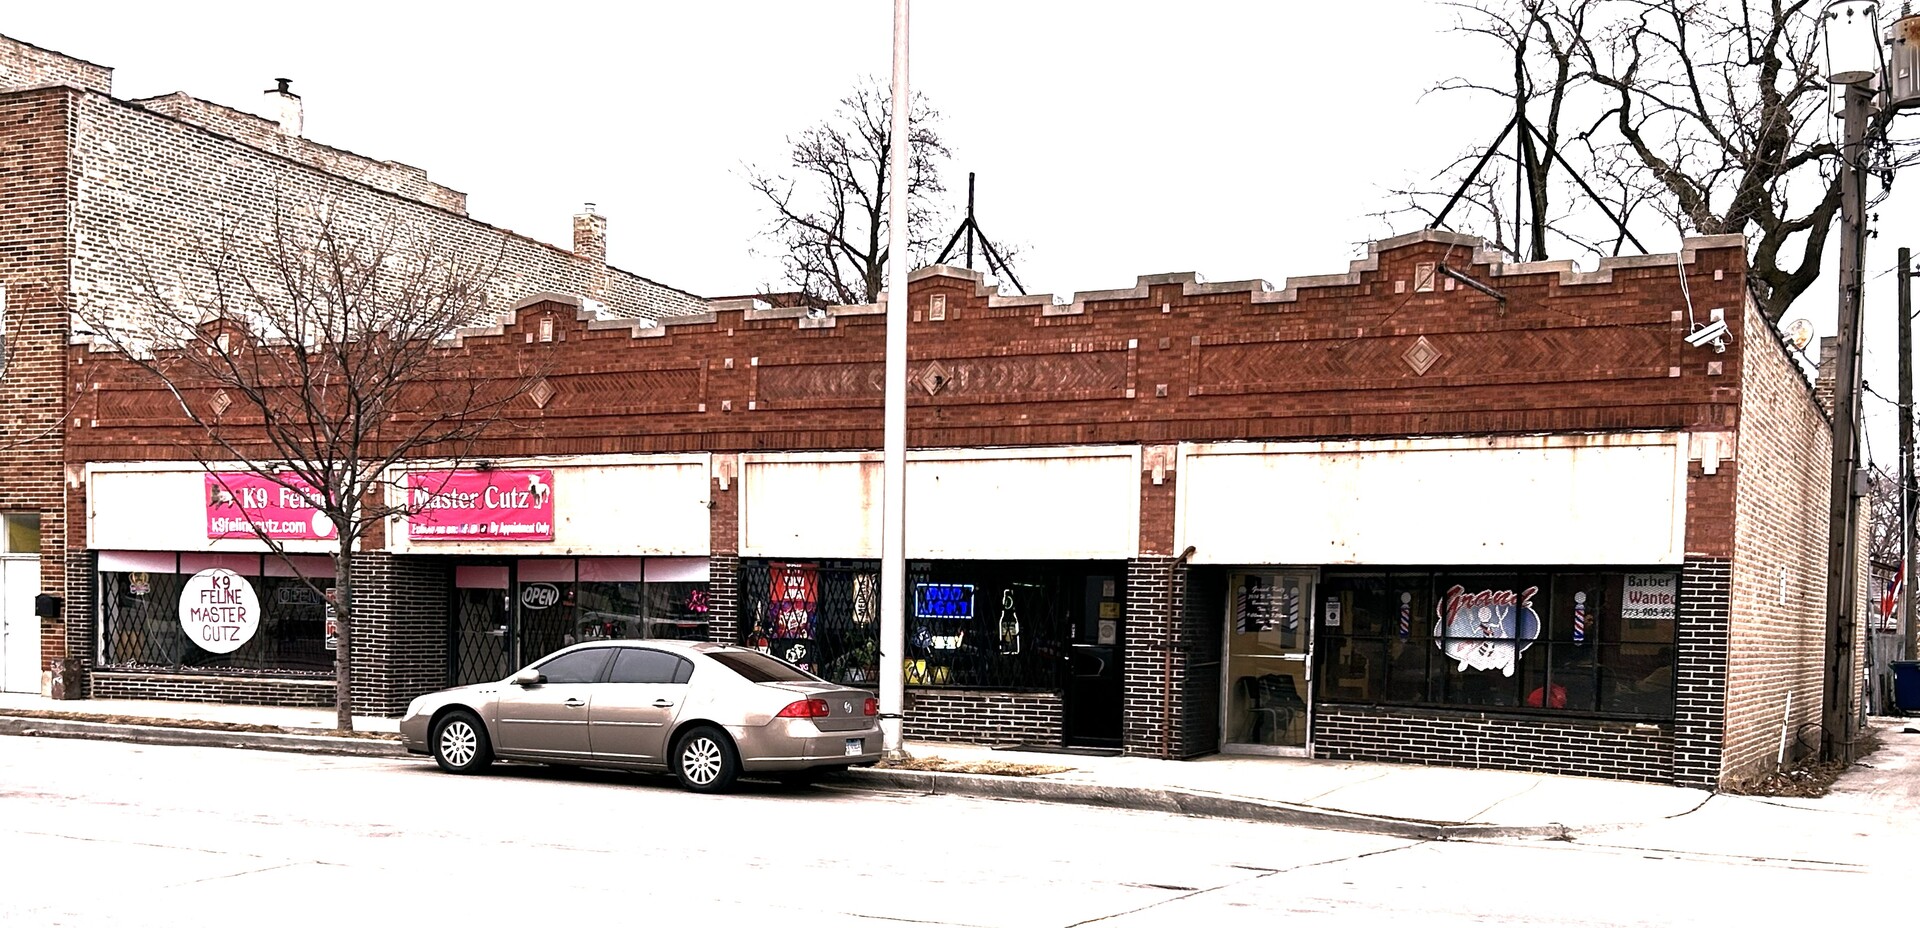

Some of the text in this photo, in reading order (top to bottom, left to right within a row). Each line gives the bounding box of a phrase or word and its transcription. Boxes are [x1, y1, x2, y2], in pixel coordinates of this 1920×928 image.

[242, 487, 328, 509] K9 Felin
[412, 485, 530, 510] Master Cutz
[490, 522, 550, 536] By Appointment Only
[212, 575, 231, 590] K9
[200, 589, 243, 605] FELINE
[280, 589, 319, 602] OPEN
[524, 586, 555, 606] OPEN
[190, 606, 247, 623] MASTER
[202, 625, 241, 641] CUTZ
